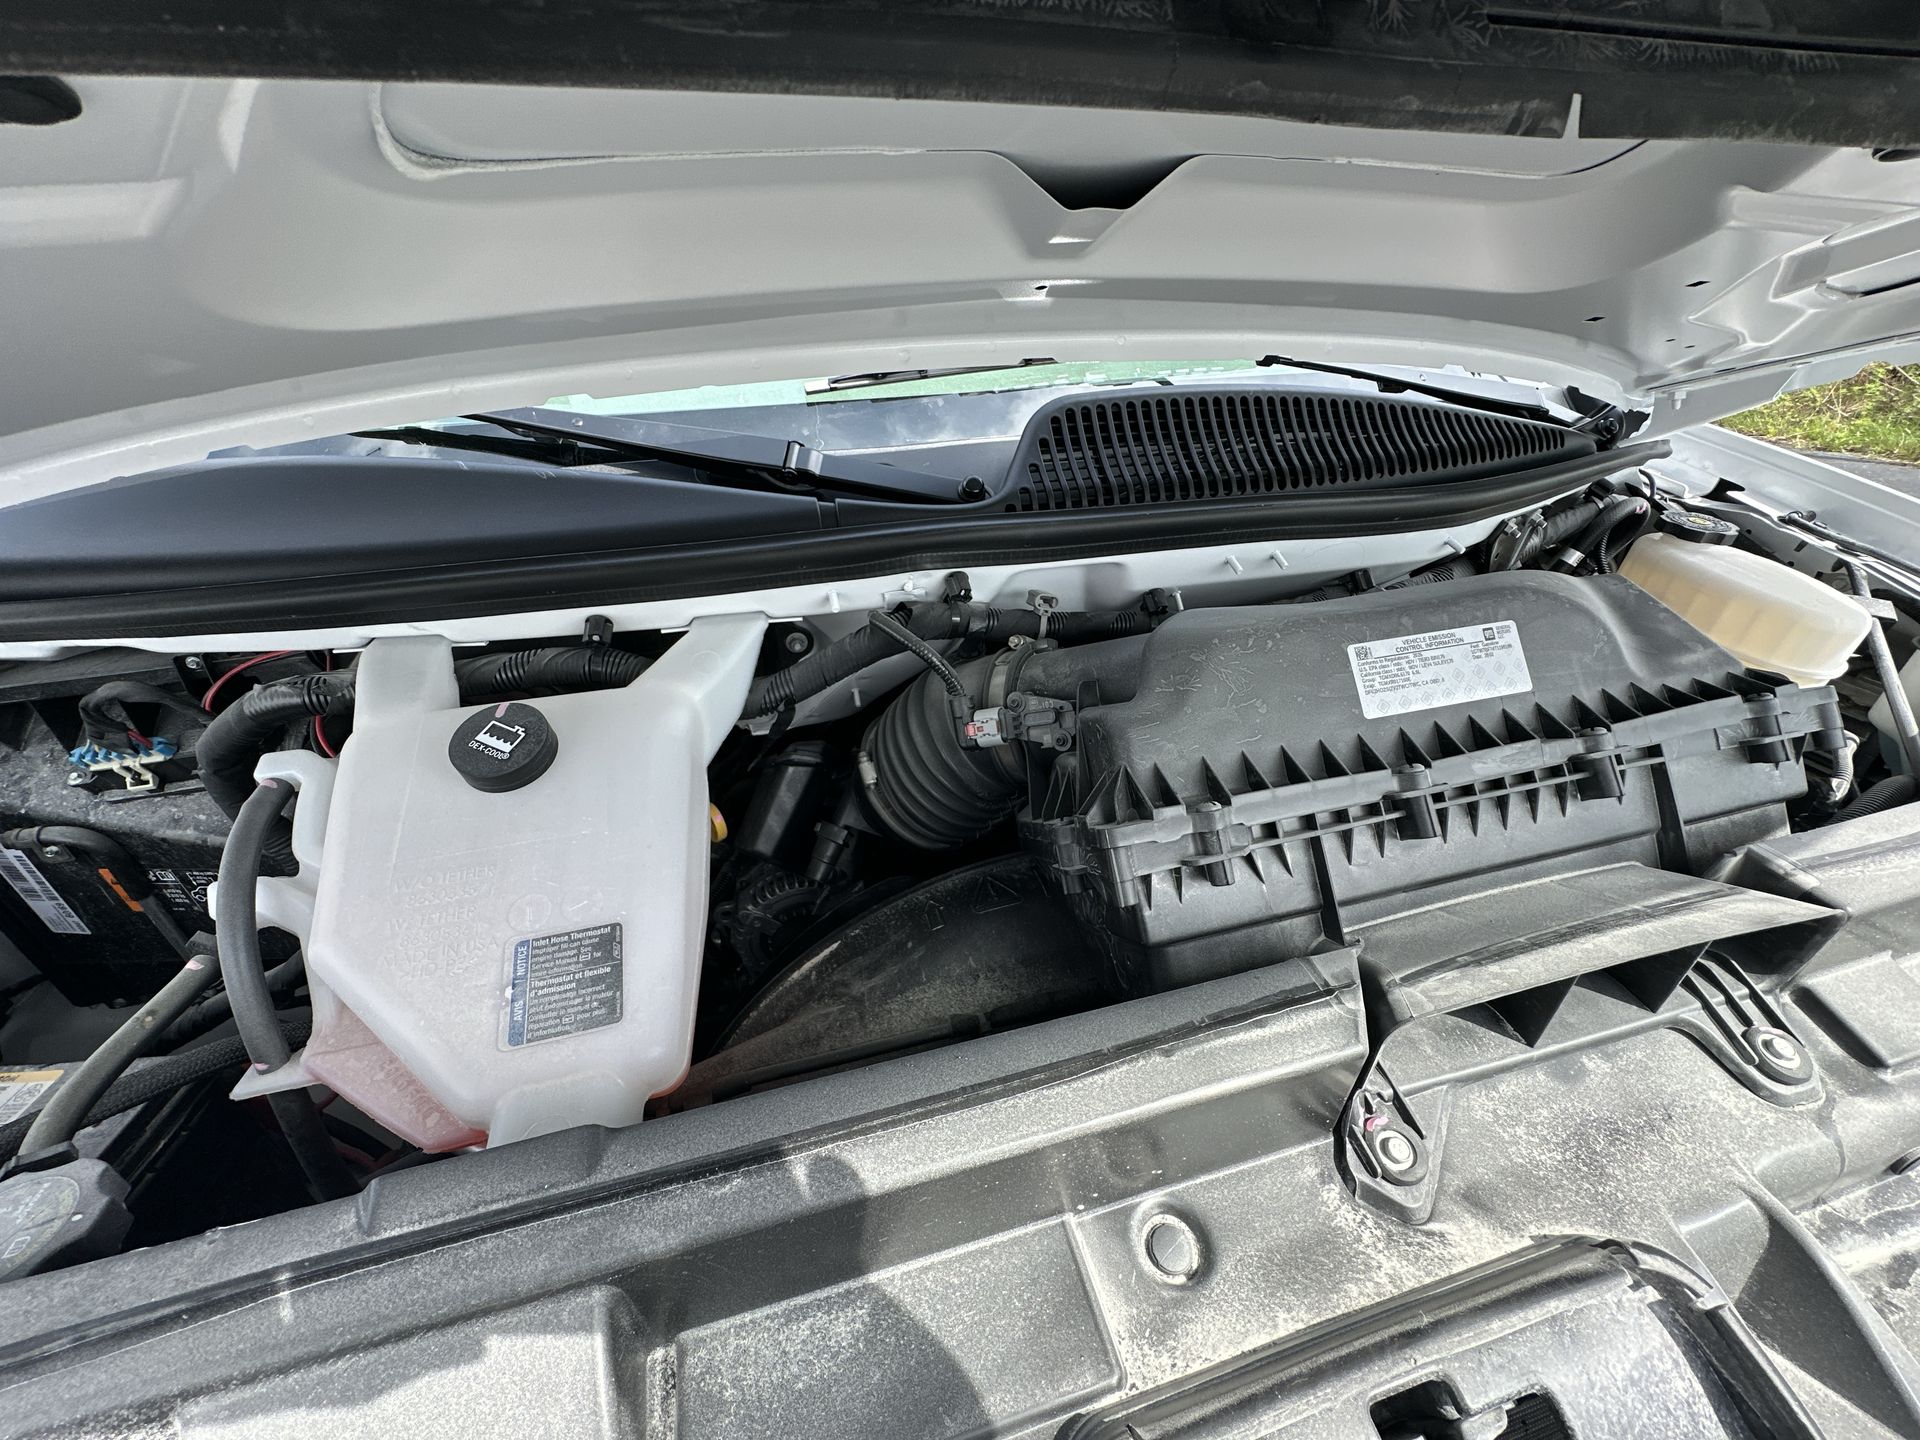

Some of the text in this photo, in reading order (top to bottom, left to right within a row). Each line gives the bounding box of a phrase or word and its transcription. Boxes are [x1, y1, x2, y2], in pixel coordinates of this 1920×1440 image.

[1396, 637, 1464, 653] CONTROL INFORMATION
[1402, 632, 1455, 645] VEHICLE EMISSION
[533, 938, 549, 947] Inlet
[551, 935, 568, 944] Hose
[570, 926, 611, 940] Thermostat
[533, 945, 559, 956] Improper
[581, 937, 599, 945] cause
[517, 946, 527, 976] NOTICE
[532, 955, 553, 963] engine
[532, 962, 555, 970] Service
[556, 956, 578, 965] Manual
[531, 973, 573, 988] Thermostat
[584, 966, 611, 976] flexible
[530, 982, 576, 997] d'admission
[578, 984, 605, 994] incorrect
[514, 1001, 523, 1020] AVIS
[577, 1012, 591, 1020] pour
